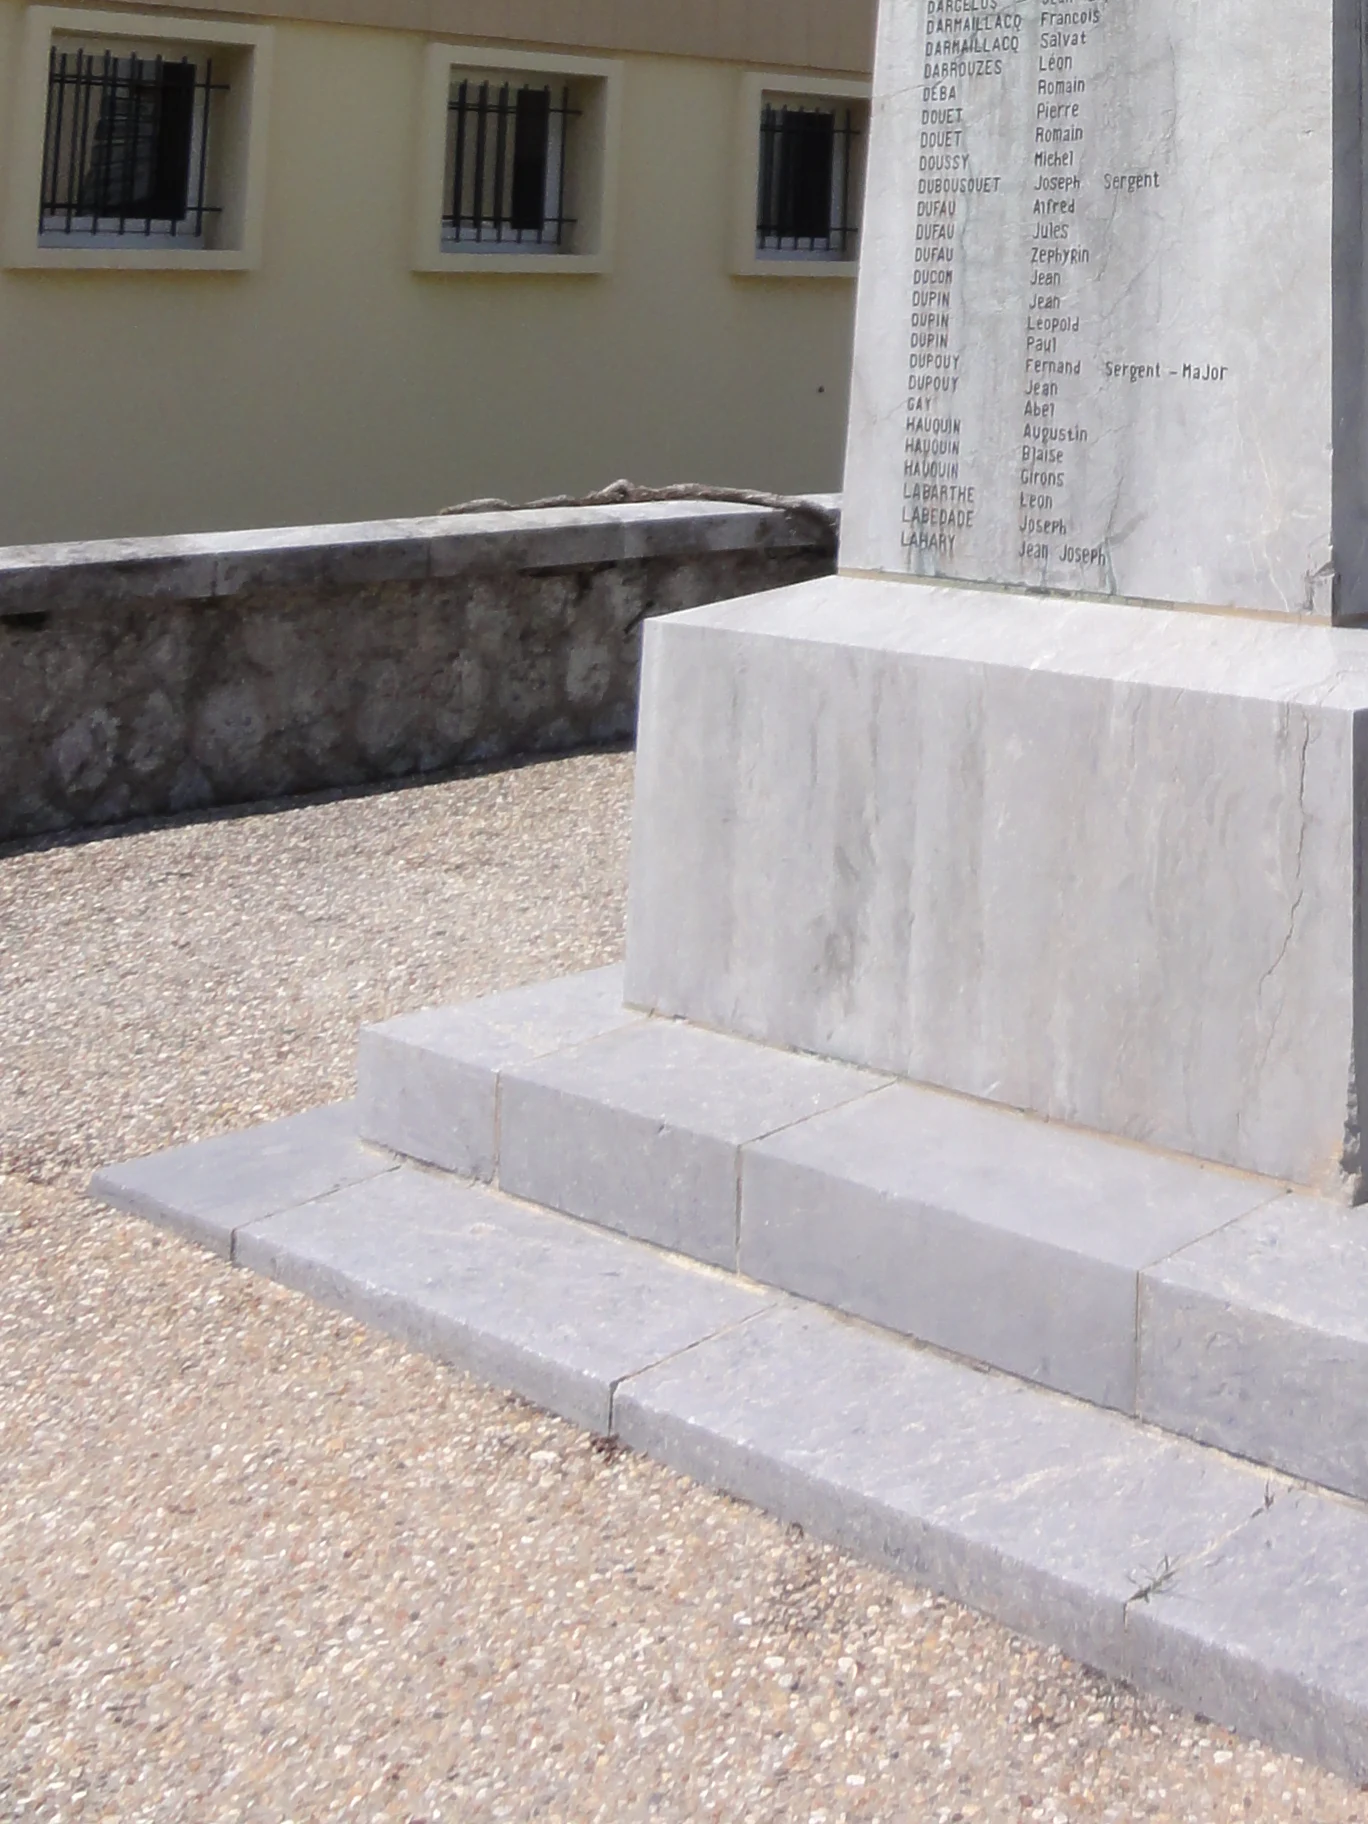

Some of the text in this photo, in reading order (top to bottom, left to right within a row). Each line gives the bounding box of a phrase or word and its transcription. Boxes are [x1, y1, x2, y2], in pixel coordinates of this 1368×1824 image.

[926, 14, 1022, 35] DARMAILLACQ
[925, 31, 1087, 56] DARMAILLACQ Salvat
[1039, 52, 1073, 72] Léon
[1037, 76, 1085, 95] Romain
[921, 101, 1079, 125] DOUET Pierre
[920, 124, 1083, 148] DOUET Romain
[919, 150, 1073, 171] DOUSSY Michel
[1034, 175, 1081, 192] Joseph
[1103, 171, 1160, 193] Sergent
[917, 198, 1075, 217] DUFAU Alfred
[915, 221, 1069, 240] DUFAU Jules
[914, 247, 954, 263] DUFAU
[1030, 270, 1061, 286] Jean
[912, 290, 1060, 310] DUPIN Jean
[911, 312, 949, 328] DUPIN
[910, 332, 1057, 353] DUPIN Paul
[909, 353, 960, 370] DUPOUY
[1025, 358, 1082, 375] Fernand
[1104, 360, 1161, 383] Sergent
[908, 375, 1058, 396] DUPOUY Jean
[907, 396, 1055, 417] GAY Abel
[906, 417, 1088, 444] HAUQUIN Augustin
[1021, 445, 1064, 464] Blaise
[1020, 468, 1065, 488] Girons
[903, 482, 975, 503] LABARTHE
[902, 505, 1067, 536] LABEDADE Joseph
[901, 531, 1107, 566] LAHARY Jean Joseph
